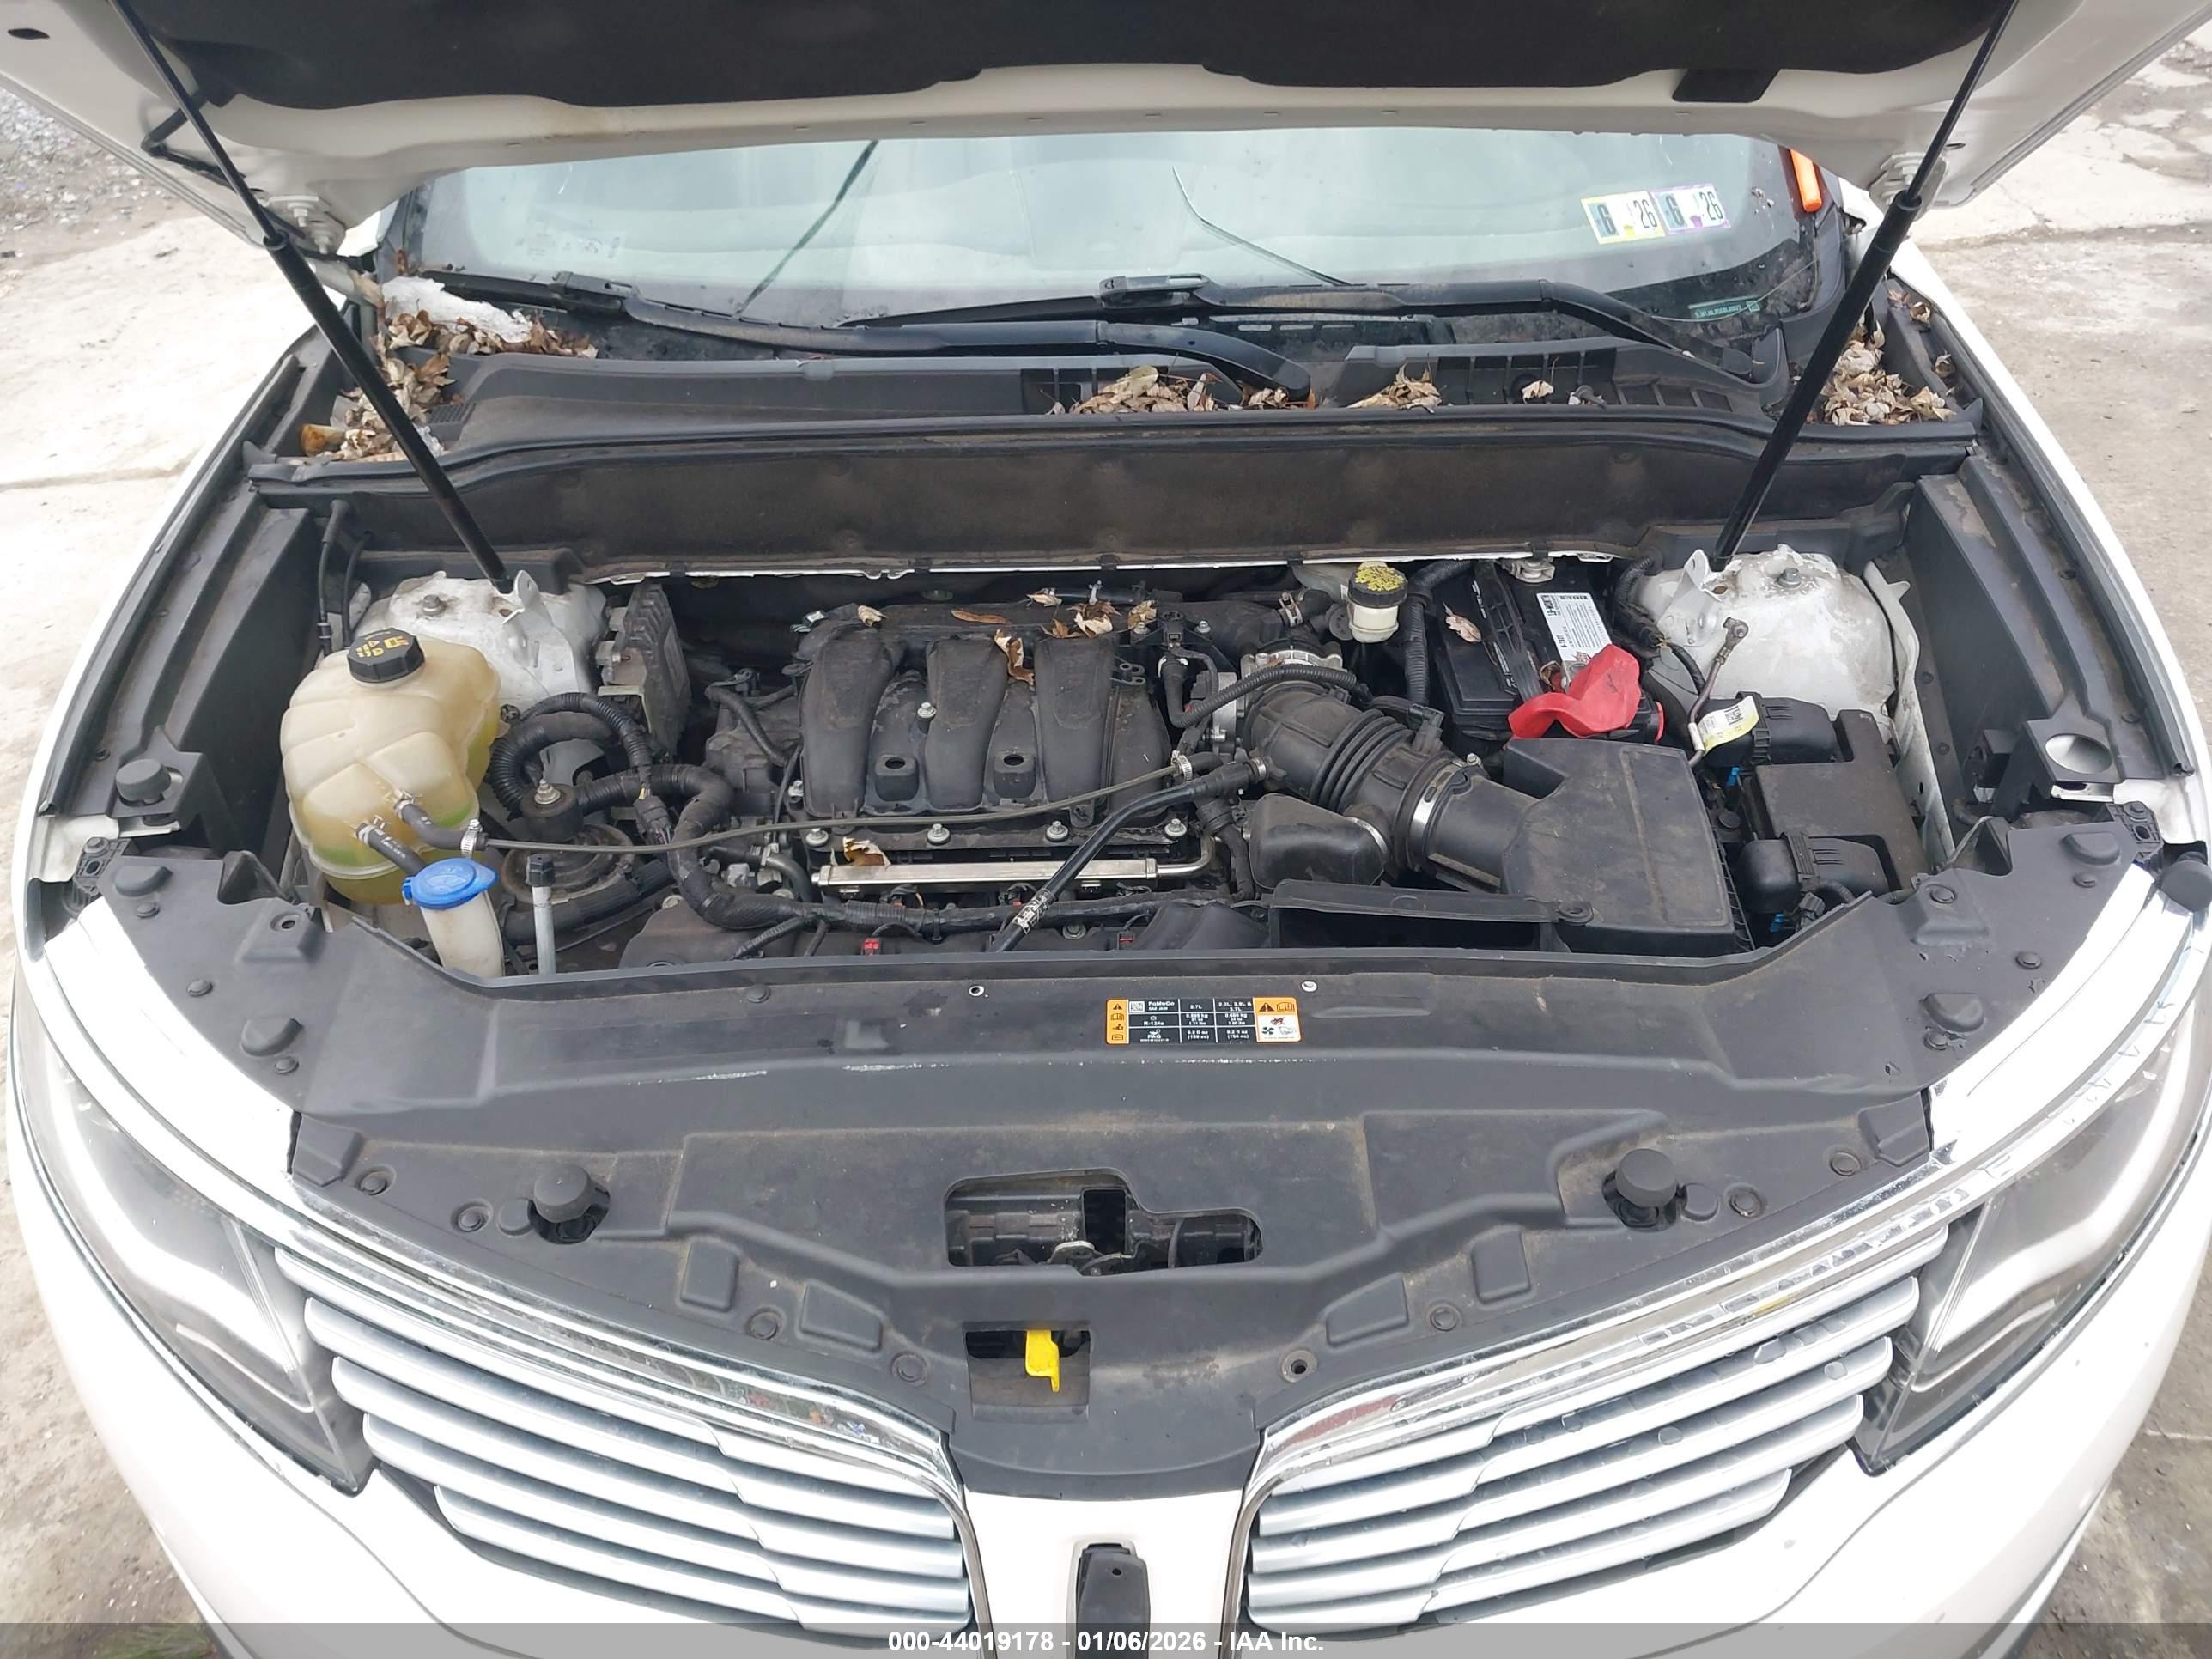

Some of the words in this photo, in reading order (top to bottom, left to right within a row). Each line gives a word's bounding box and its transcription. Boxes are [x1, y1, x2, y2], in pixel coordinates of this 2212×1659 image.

[1597, 204, 1616, 234] 6
[1633, 199, 1658, 228] 26
[1666, 195, 1685, 226] 6
[1699, 191, 1723, 221] 26
